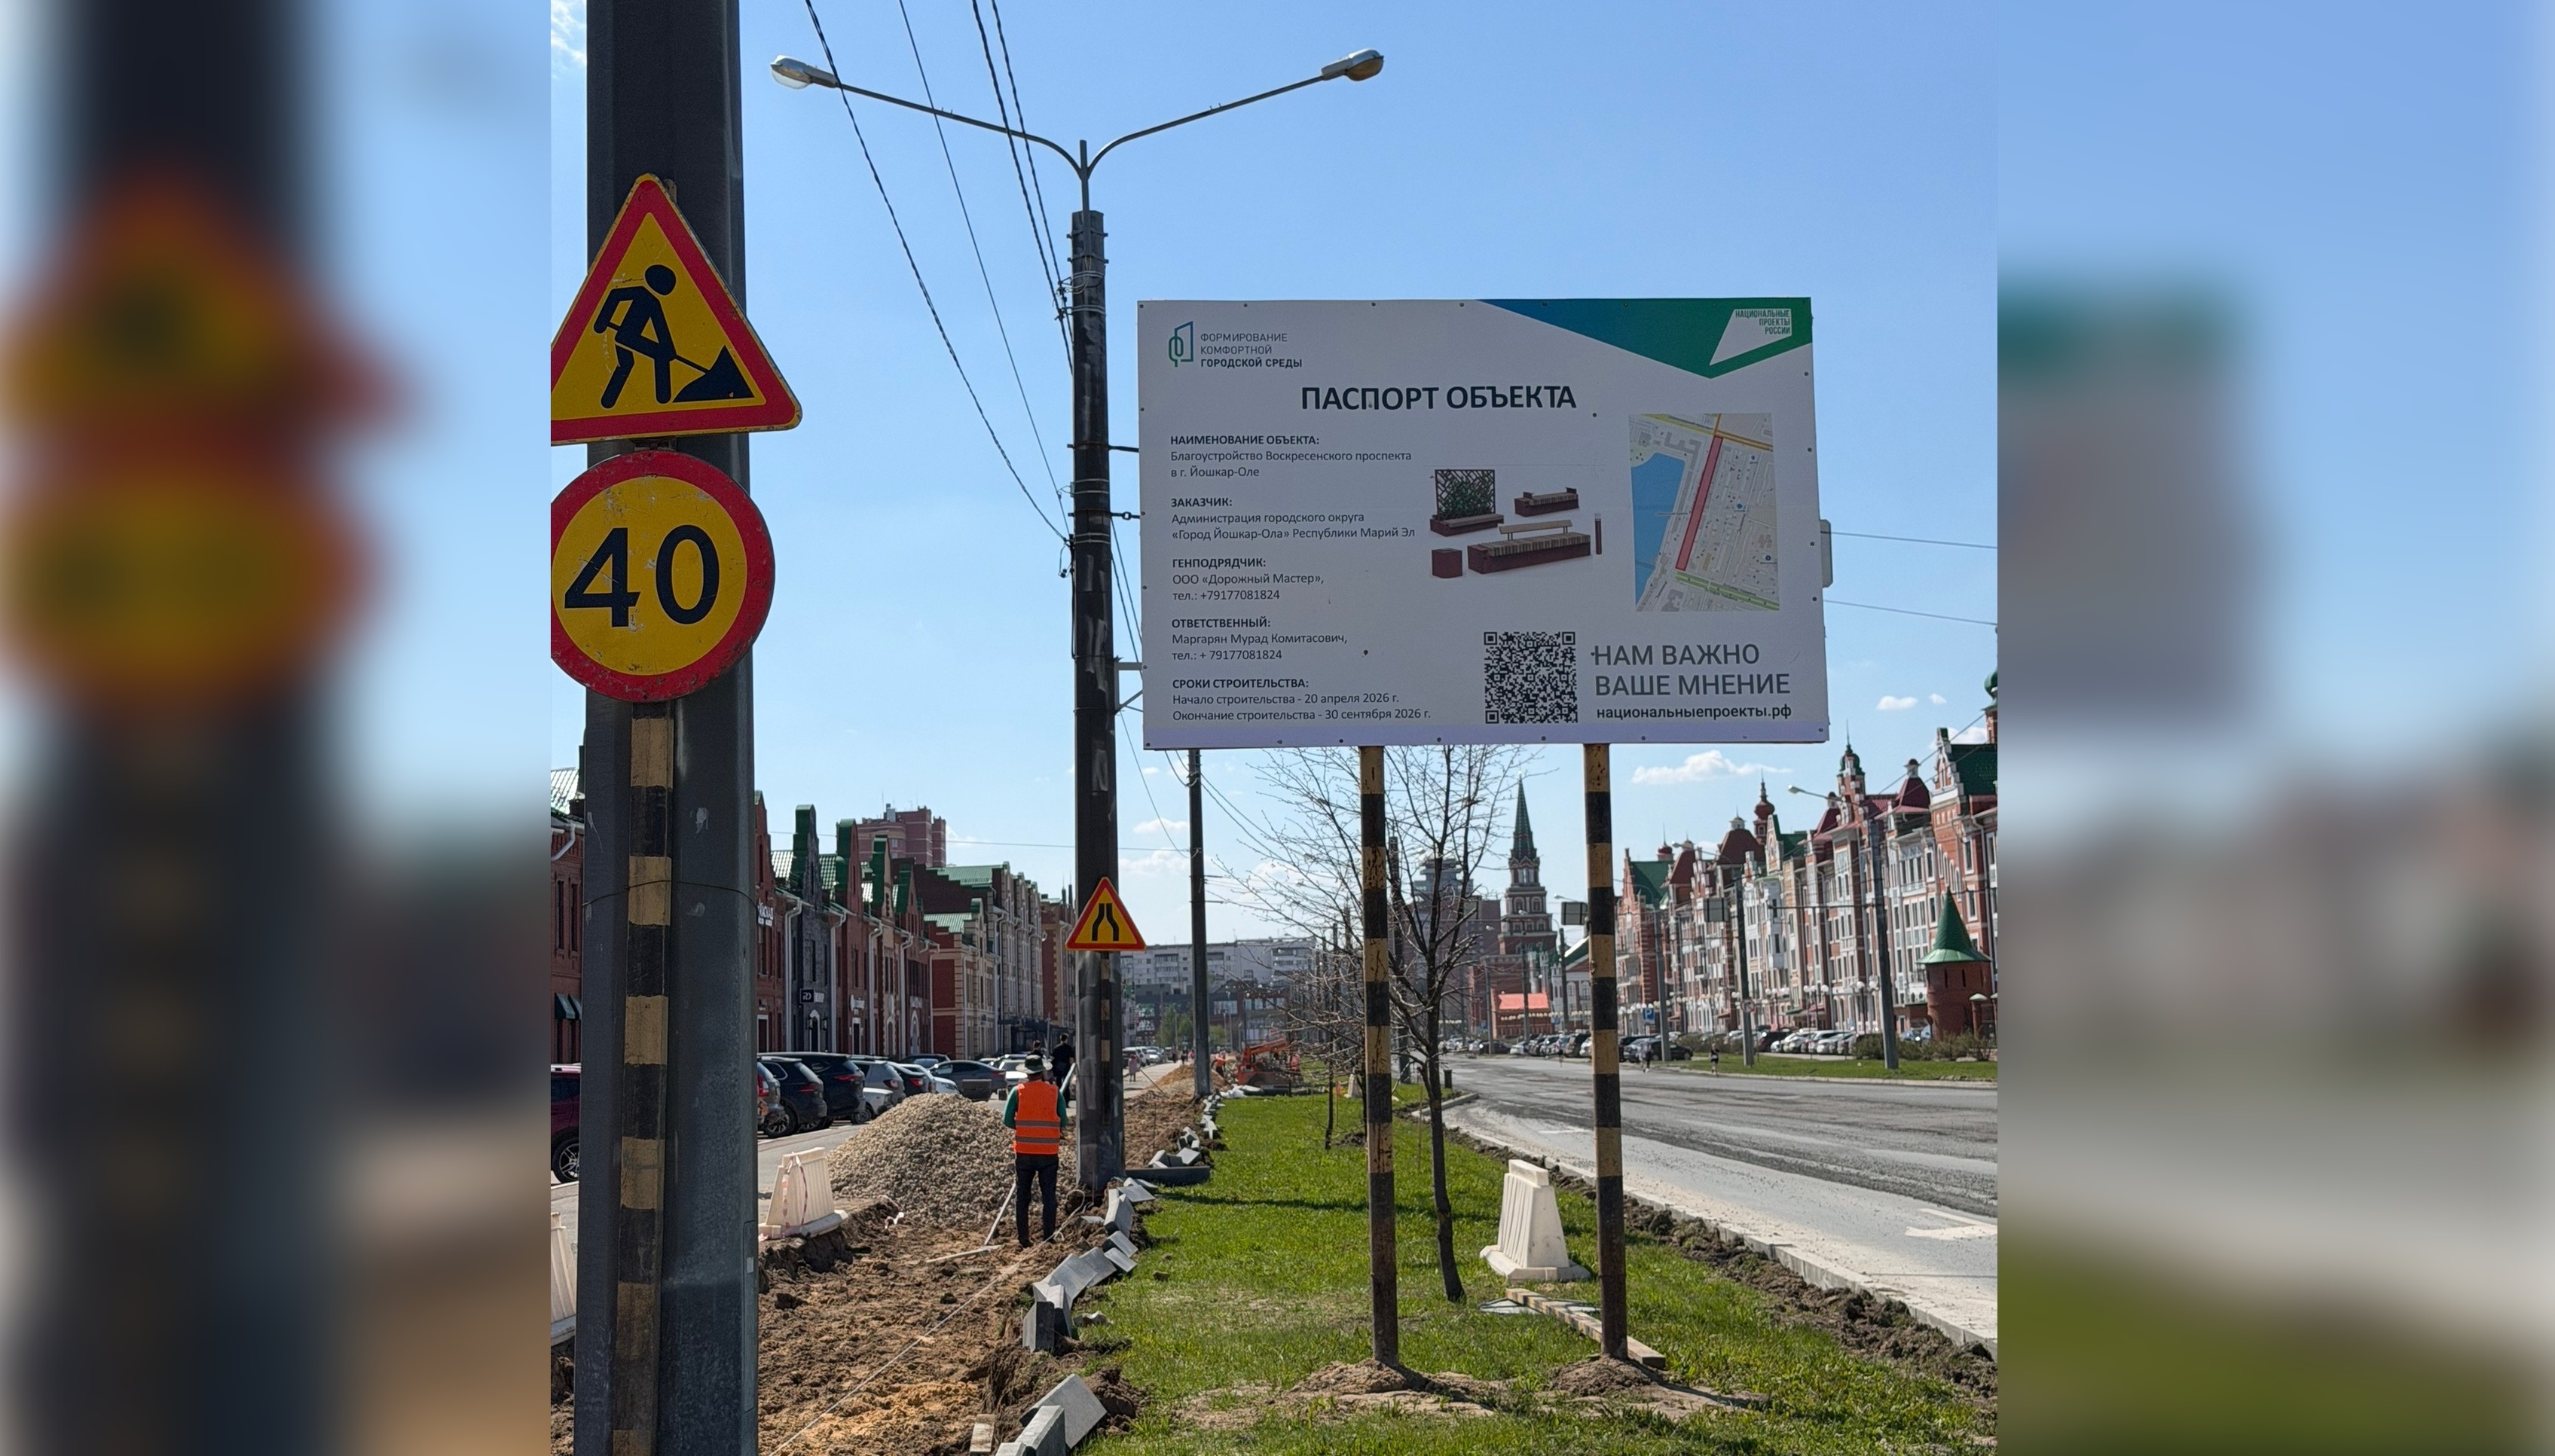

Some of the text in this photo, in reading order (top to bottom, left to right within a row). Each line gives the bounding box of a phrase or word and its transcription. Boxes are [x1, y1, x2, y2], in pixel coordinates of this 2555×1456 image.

[1200, 333, 1288, 343] ФОРМИРОВАНИЕ
[1200, 343, 1273, 355] КОМФОРТНОЙ
[1200, 356, 1303, 369] ГОРОДСКОЙ СРЕДЫ
[1301, 385, 1577, 411] ПАСПОРТ ОБЪЕКТА
[1170, 435, 1319, 445] НАИМЕНОВАНИЕ ОБЪЕКТА:
[1171, 450, 1412, 463] Благоустройство Воскресенского проспекта
[1171, 465, 1260, 479] в г. Йошкар-Оле
[1171, 497, 1233, 508] ЗАКАЗЧИК:
[1171, 514, 1365, 526] Администрация городского округа
[1172, 527, 1415, 542] «Город Йошкар-Ола» Республики Марий Эл
[1172, 557, 1266, 570] ГЕНПОДРЯДЧИК:
[564, 525, 720, 627] 40
[1172, 573, 1324, 586] ООО «Дорожный Мастер»,
[1172, 589, 1280, 601] тел.: +79177081824
[1172, 615, 1271, 628] ОТВЕТСТВЕННЫЙ:
[1172, 633, 1347, 646] Маргарян Мурад Комитасович,
[1172, 652, 1197, 661] тел.:
[1209, 649, 1282, 661] 79177081824
[1594, 643, 1759, 666] НАМ ВАЖНО
[1172, 679, 1309, 689] СРОКИ СТРОИТЕЛЬСТВА:
[1595, 673, 1791, 696] ВАШЕ МНЕНИЕ
[1172, 694, 1214, 705] Начало
[1216, 696, 1295, 707] строительства
[1304, 694, 1319, 704] 20
[1320, 695, 1360, 706] апреля
[1362, 692, 1390, 703] 2026
[1392, 694, 1399, 703] г.
[1172, 710, 1234, 721] Окончание
[1236, 711, 1316, 722] строительства
[1325, 709, 1339, 719] 30
[1340, 708, 1392, 721] сентября
[1395, 708, 1422, 719] 2026
[1423, 710, 1431, 719] г.
[1597, 704, 1792, 721] национальныепроекты.рф
